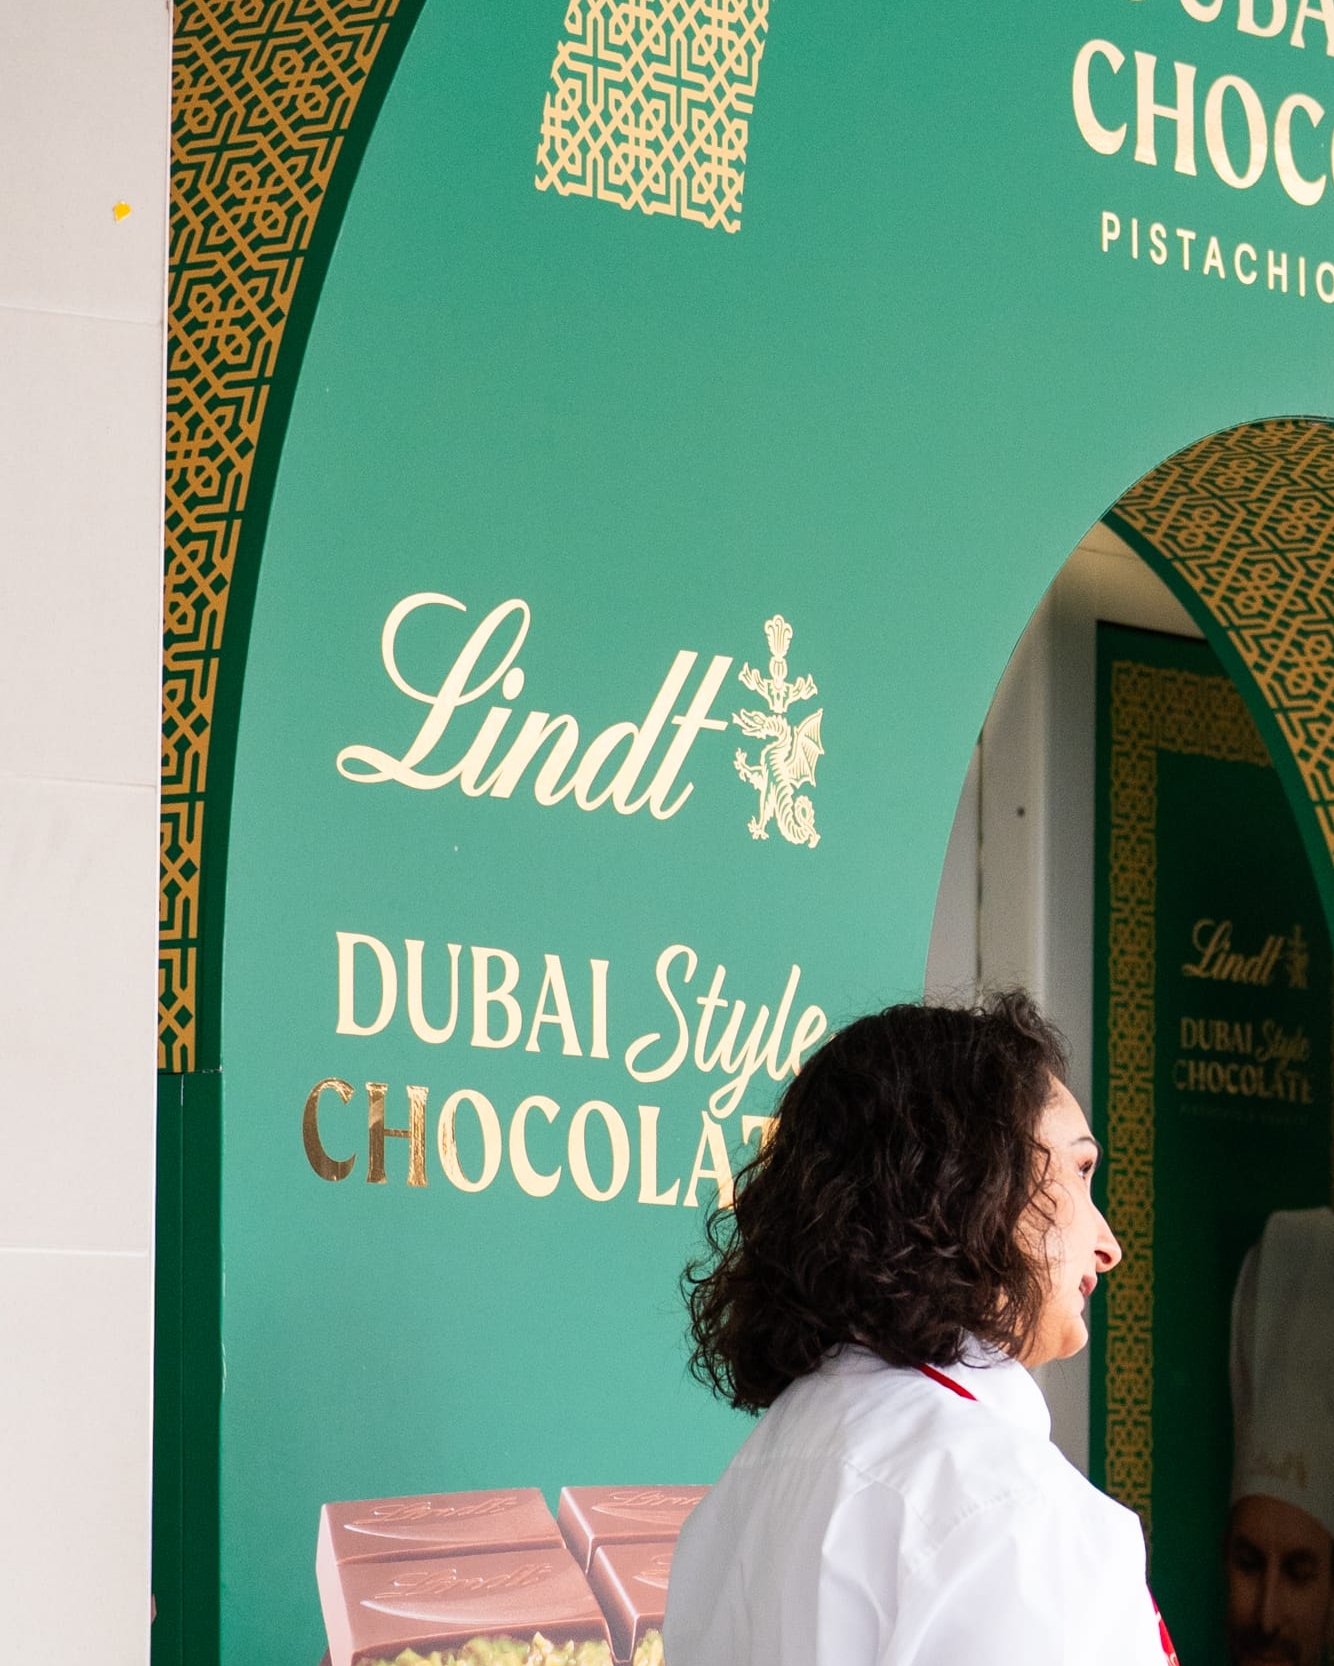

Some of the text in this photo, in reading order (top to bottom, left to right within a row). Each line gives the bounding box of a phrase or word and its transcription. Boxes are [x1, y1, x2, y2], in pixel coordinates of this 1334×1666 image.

[335, 591, 734, 821] Lindt
[1181, 918, 1286, 986] Lindt
[335, 931, 830, 1119] DUBAI Style
[1180, 1016, 1253, 1055] DUBAI
[1173, 1057, 1314, 1105] CHOCOLATE
